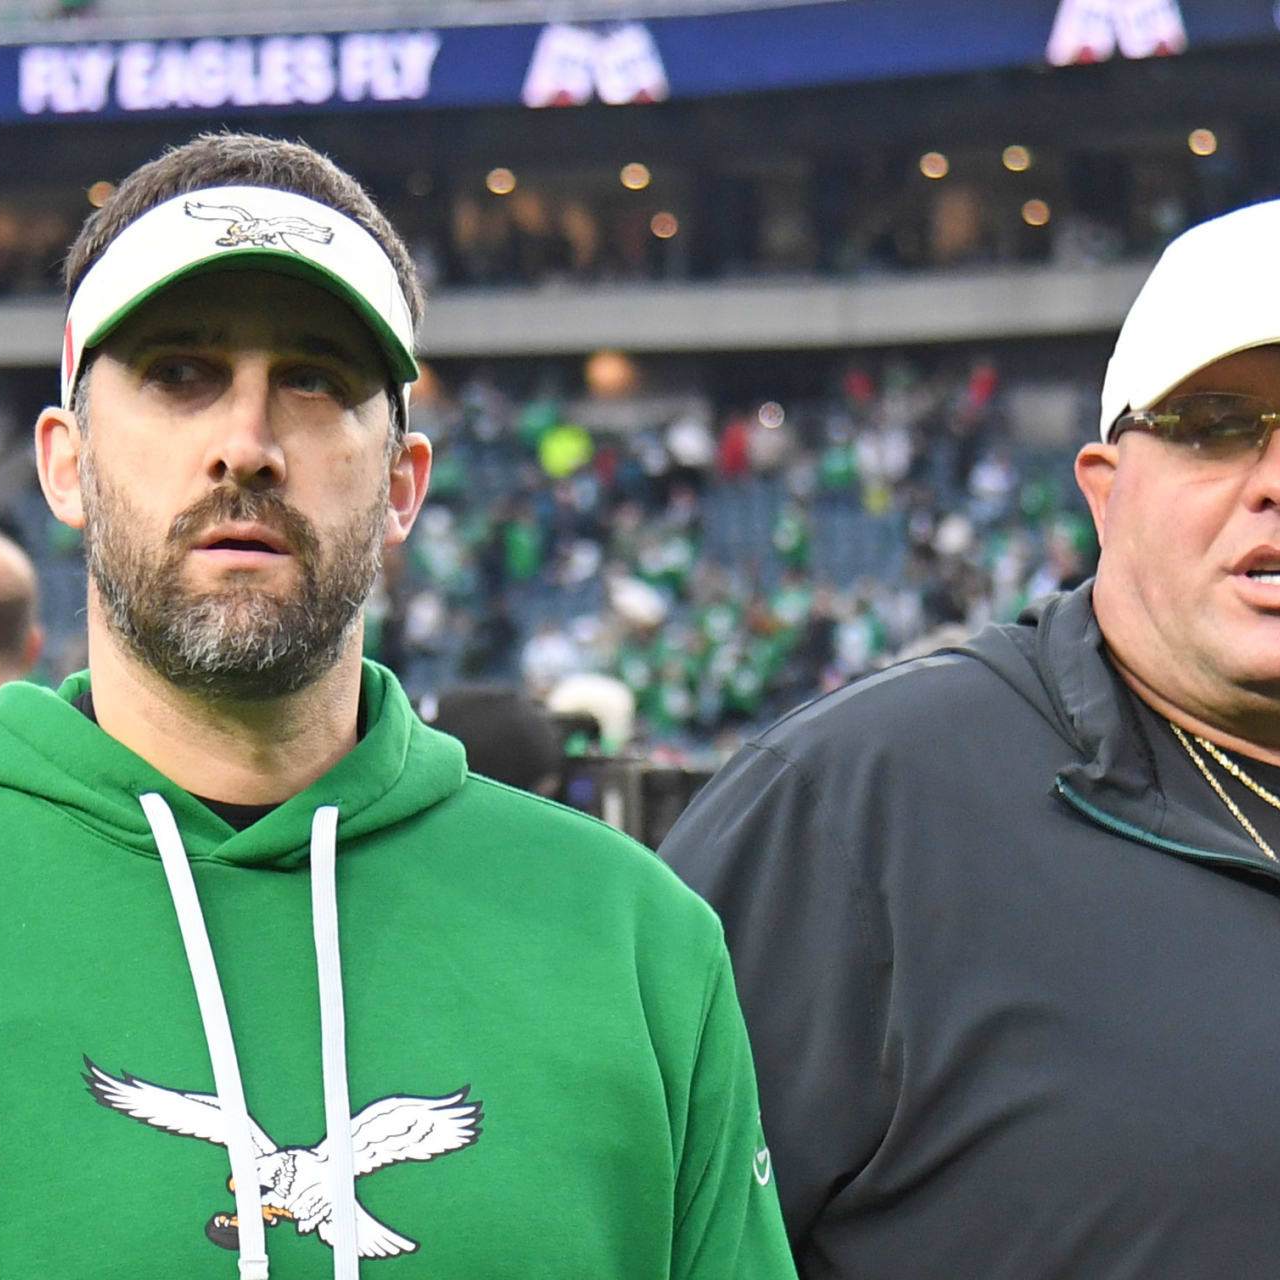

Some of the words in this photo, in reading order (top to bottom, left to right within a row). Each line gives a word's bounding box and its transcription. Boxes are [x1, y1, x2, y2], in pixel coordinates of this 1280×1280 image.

[21, 44, 114, 113] FLY
[120, 35, 334, 110] EAGLES
[339, 31, 440, 101] FLY
